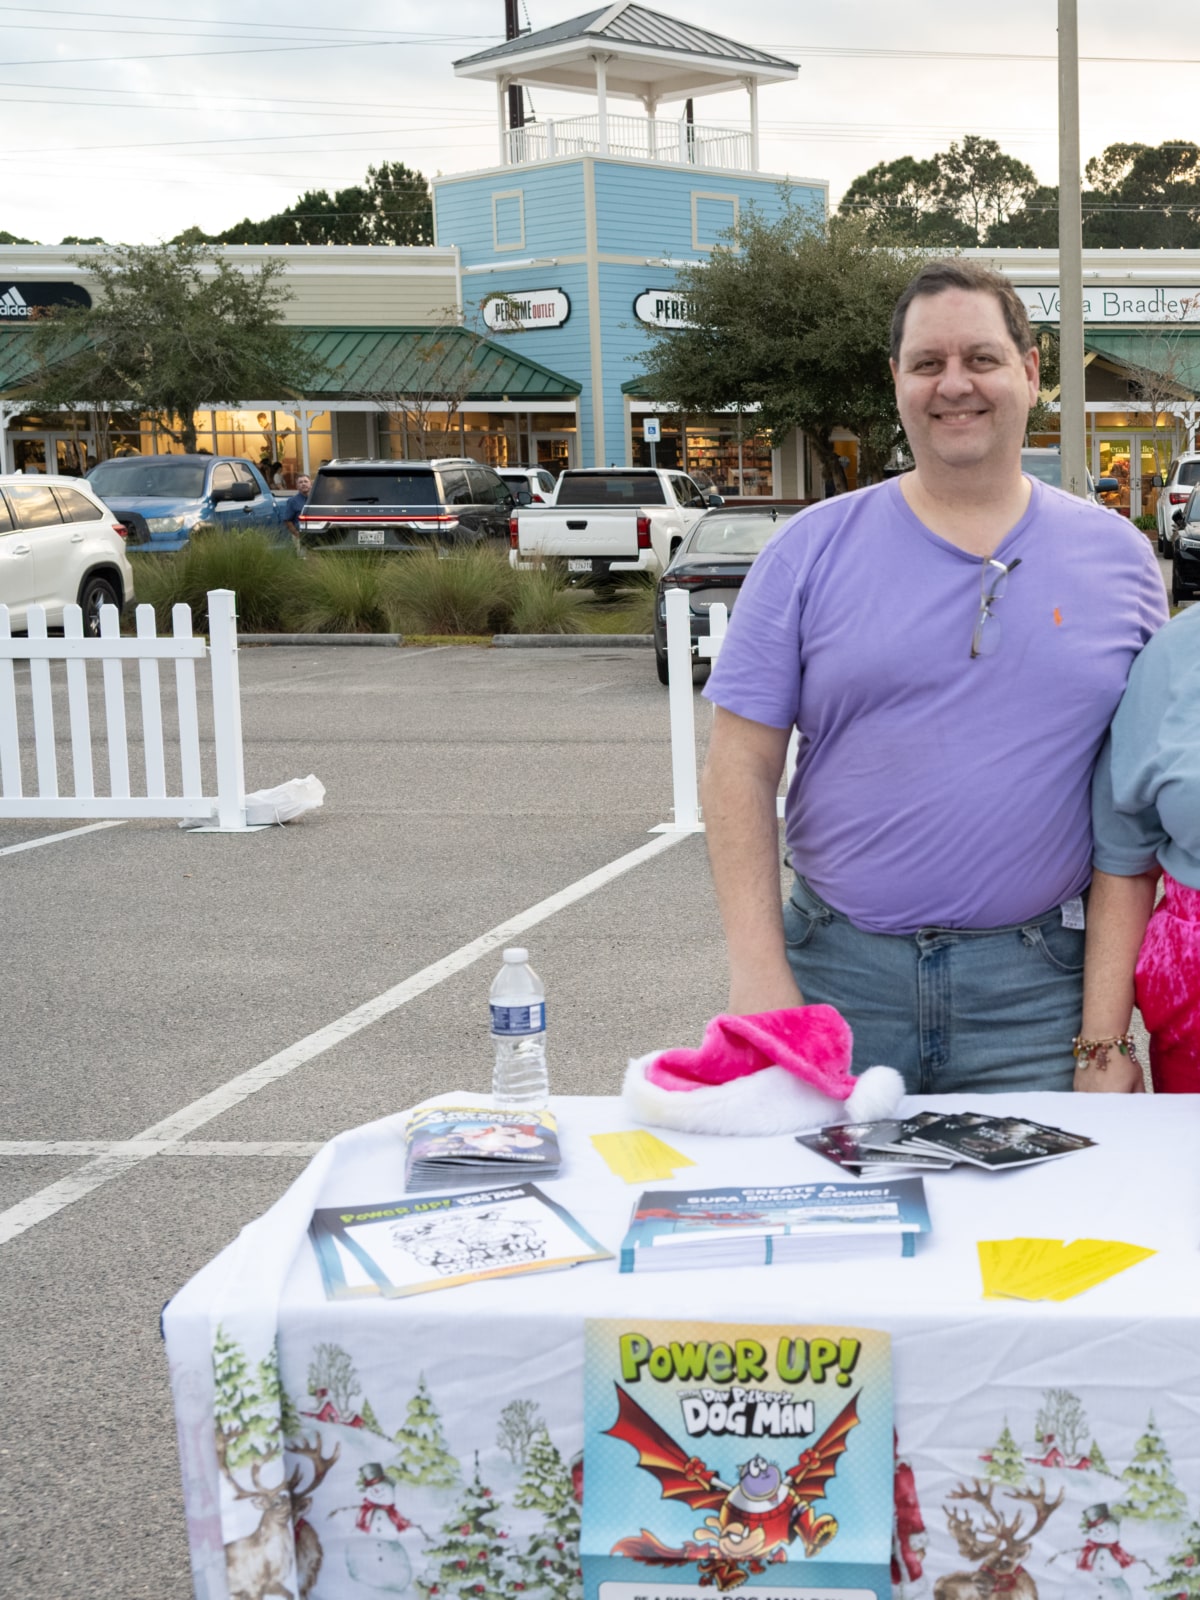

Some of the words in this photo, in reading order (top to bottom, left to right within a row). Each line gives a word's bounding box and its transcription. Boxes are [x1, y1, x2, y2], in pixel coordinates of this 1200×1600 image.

[495, 300, 531, 322] PERUME
[532, 303, 555, 319] OUTLET
[1038, 291, 1091, 317] Vea
[1102, 288, 1191, 320] Bradley
[776, 1335, 861, 1387] UP!
[681, 1398, 747, 1438] DOG
[752, 1400, 815, 1438] MAN
